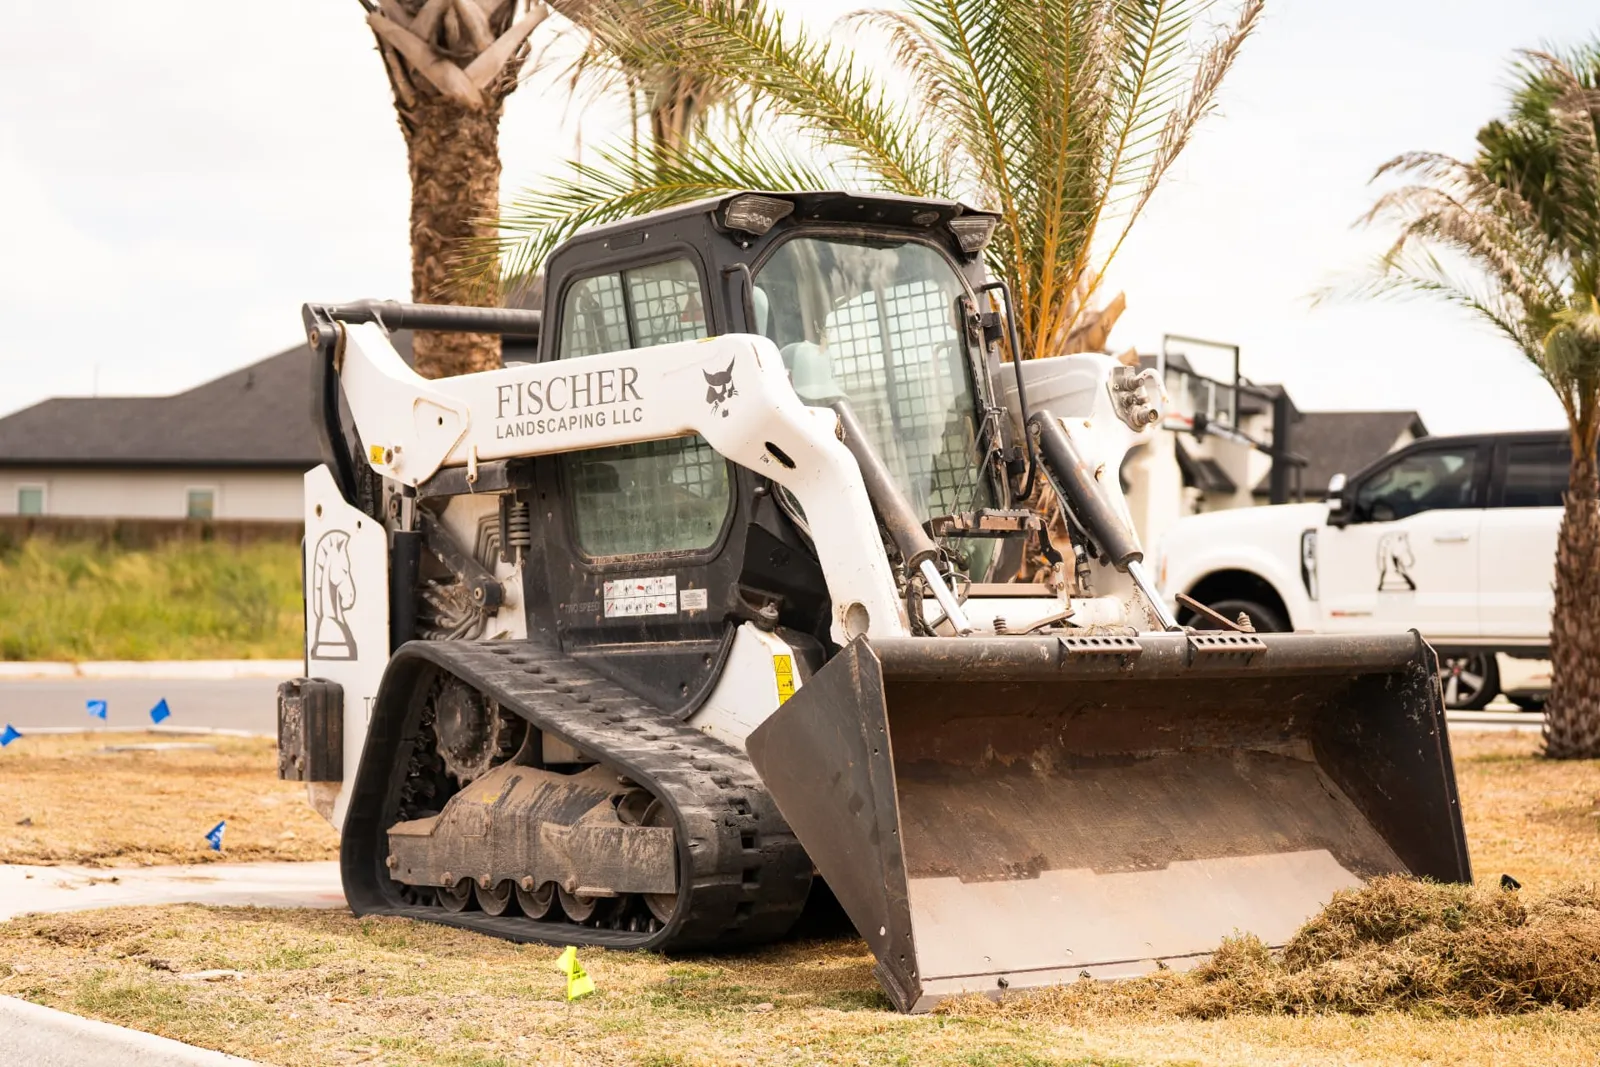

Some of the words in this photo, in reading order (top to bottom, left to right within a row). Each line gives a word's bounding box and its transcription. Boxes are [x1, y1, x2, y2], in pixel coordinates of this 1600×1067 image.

[495, 366, 644, 419] FISCHER
[496, 411, 606, 439] LANDSCAPING
[613, 407, 643, 425] LLC
[580, 601, 600, 612] SPEED
